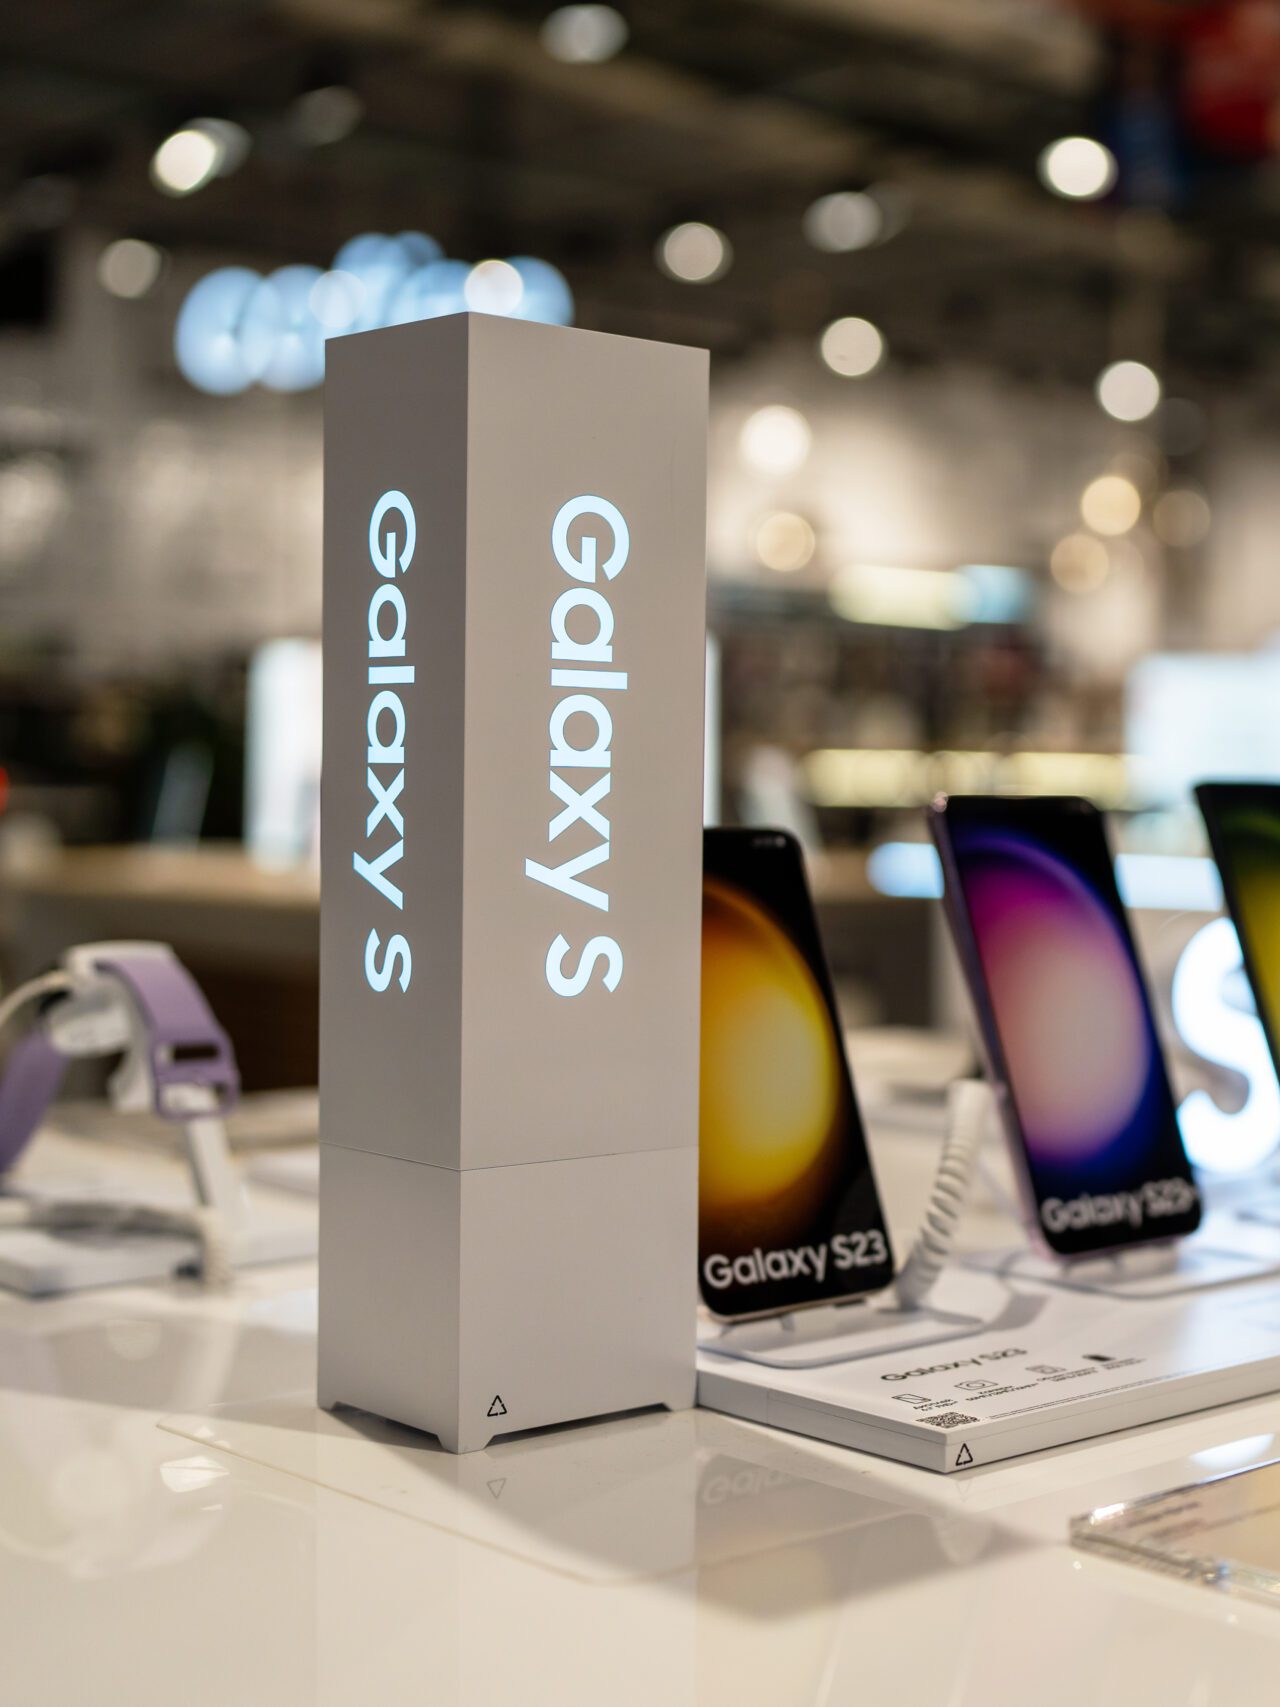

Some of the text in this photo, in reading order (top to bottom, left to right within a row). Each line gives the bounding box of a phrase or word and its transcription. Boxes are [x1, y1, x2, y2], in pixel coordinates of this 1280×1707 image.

[353, 490, 416, 993] Galaxy S
[525, 494, 630, 998] Galaxy S
[1041, 1191, 1143, 1233] Galaxy
[704, 1229, 888, 1289] Galaxy S23
[880, 1357, 982, 1381] Galaxy
